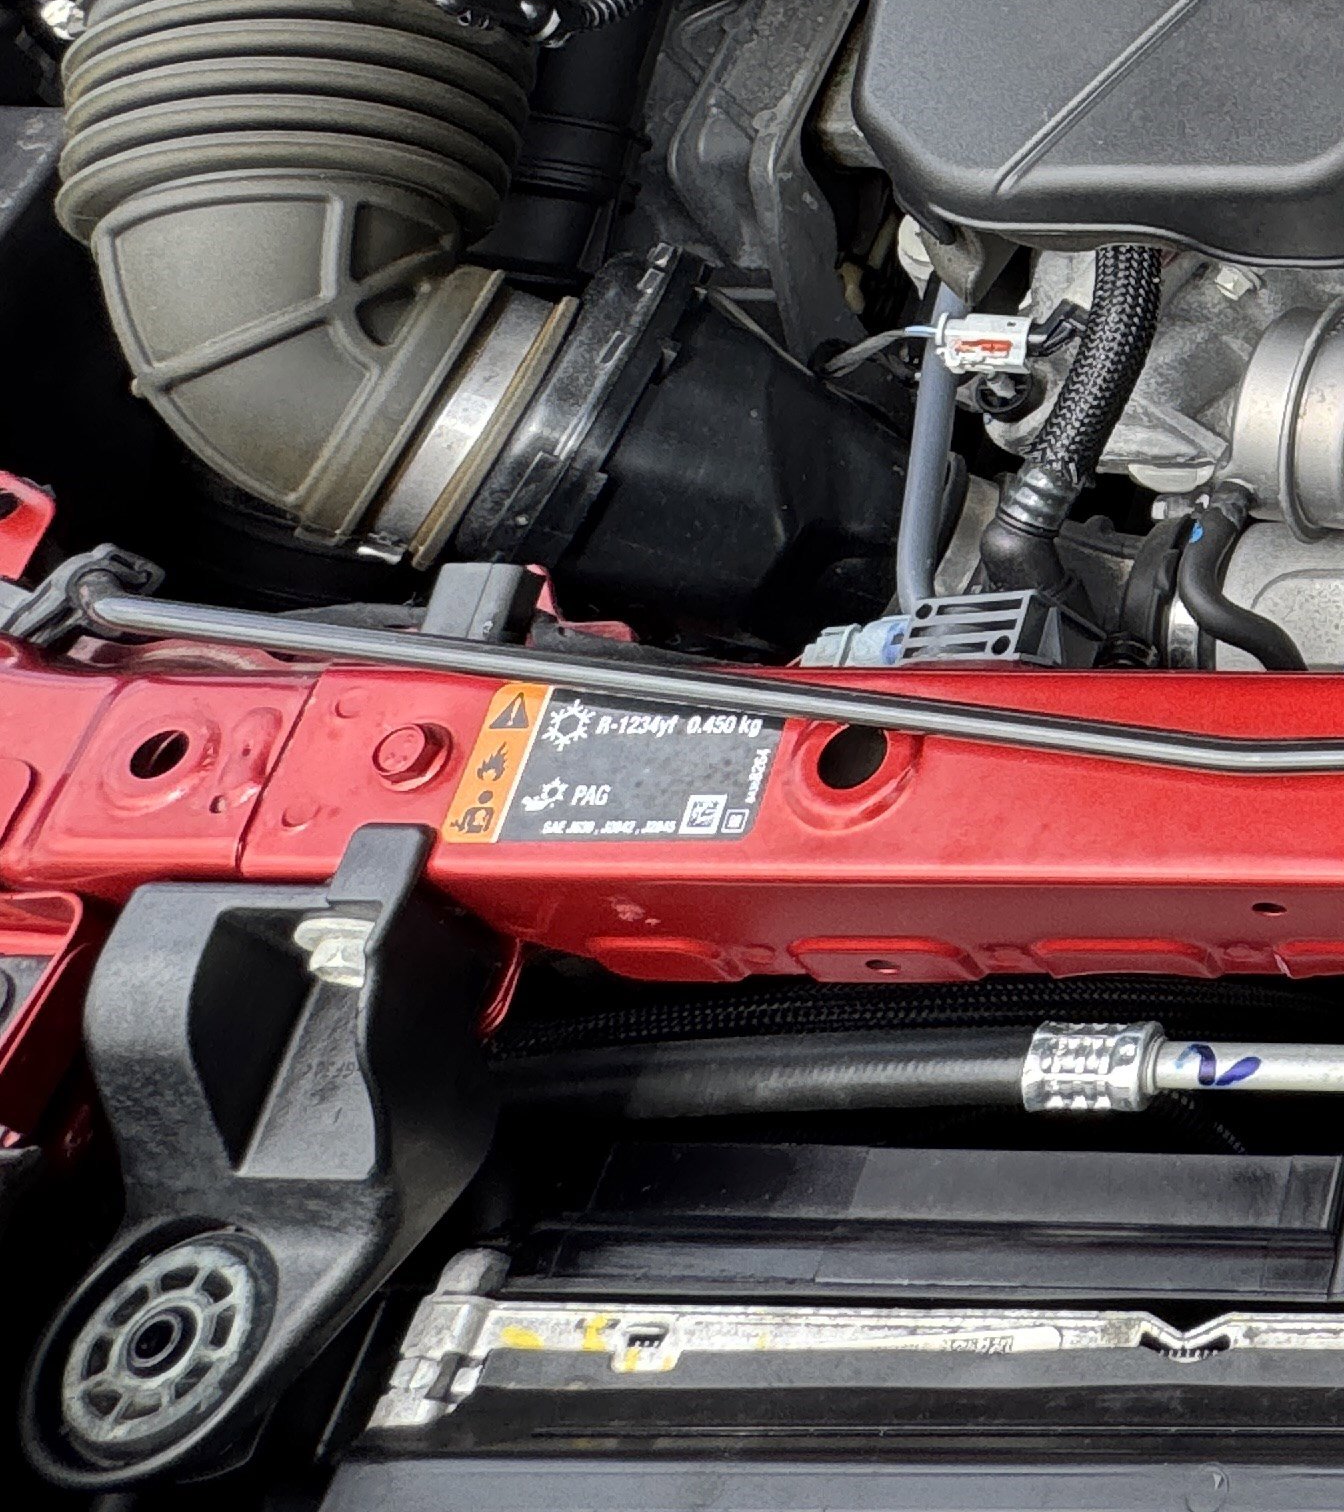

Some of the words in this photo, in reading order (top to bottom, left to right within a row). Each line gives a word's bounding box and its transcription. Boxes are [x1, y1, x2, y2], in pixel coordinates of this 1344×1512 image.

[595, 715, 679, 738] R-1234yf
[686, 715, 736, 735] 0.450
[739, 715, 763, 737] kg
[571, 785, 612, 806] PAG
